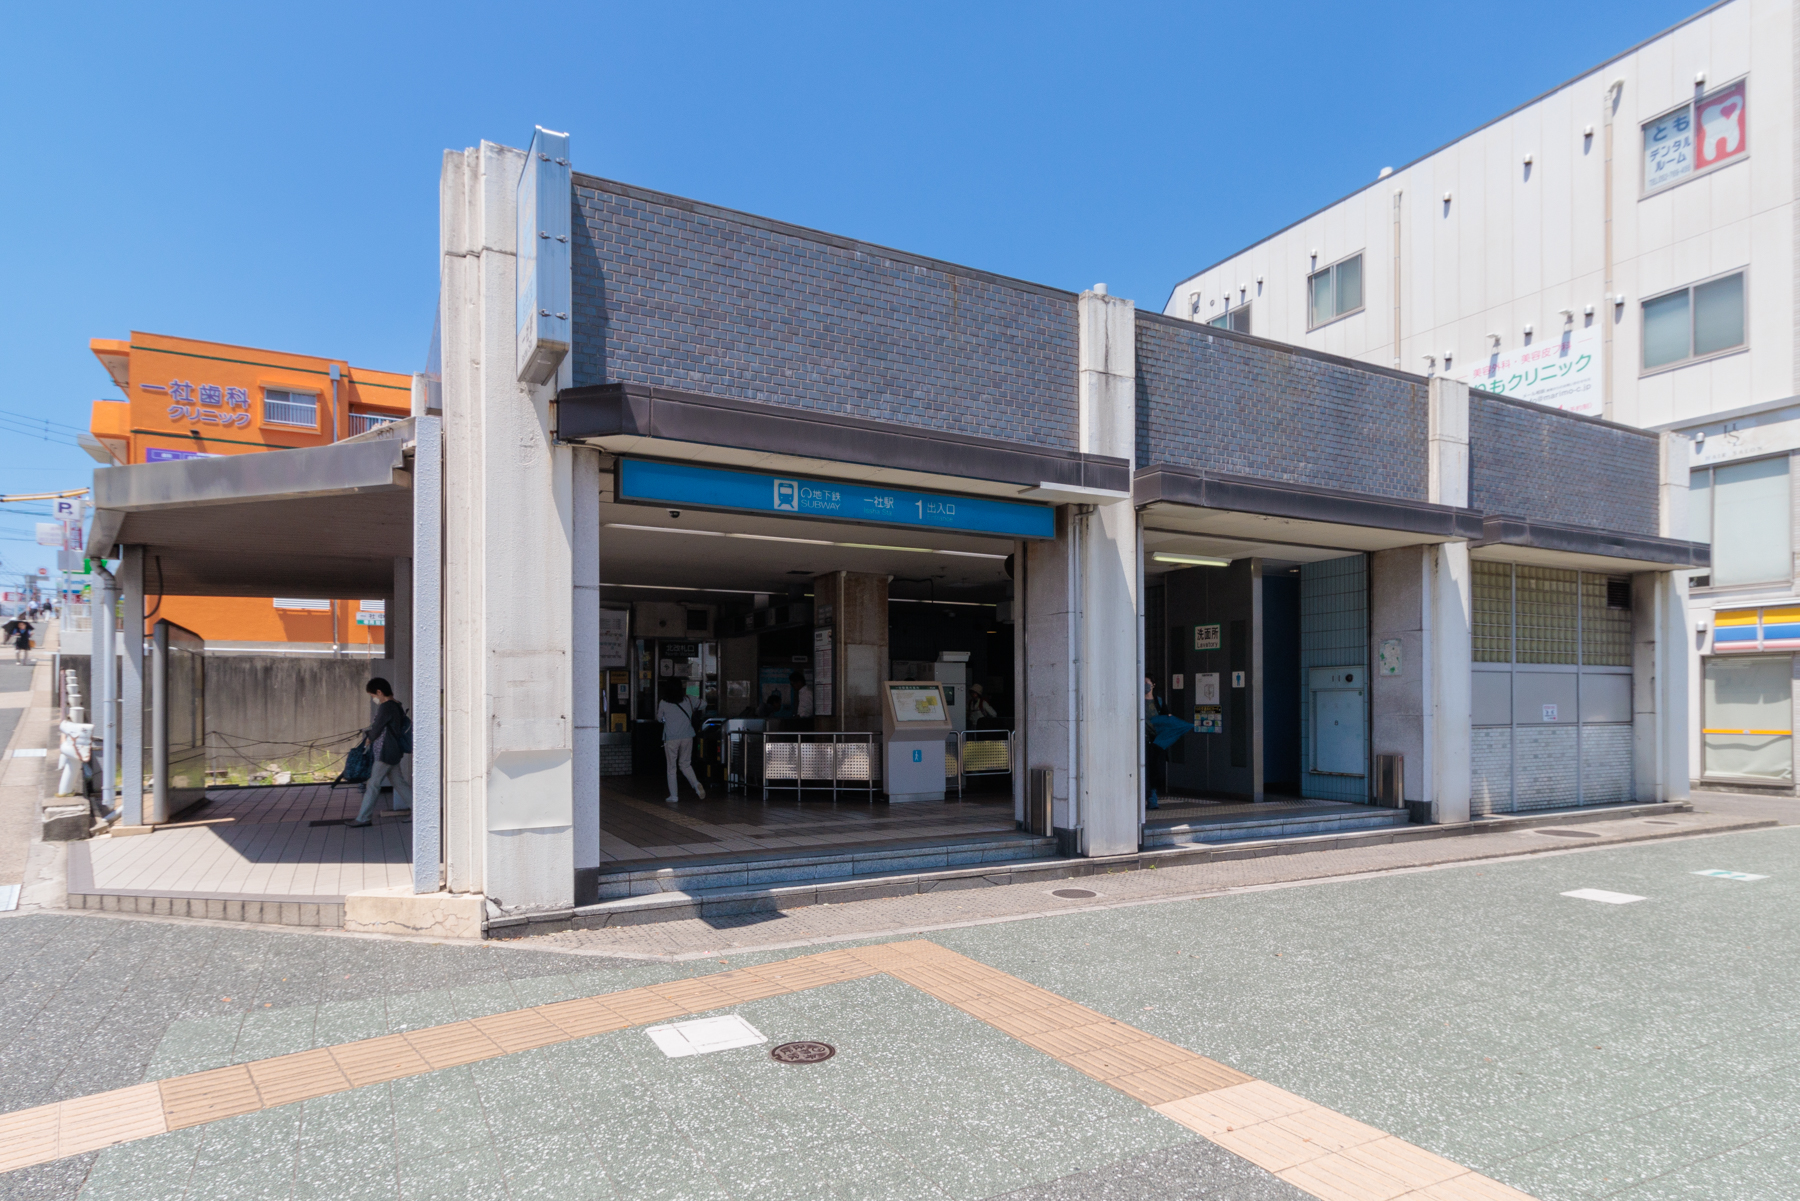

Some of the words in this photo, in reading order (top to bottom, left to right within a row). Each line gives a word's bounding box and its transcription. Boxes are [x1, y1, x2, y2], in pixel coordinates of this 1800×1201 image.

[1653, 115, 1691, 142] とも
[1650, 135, 1692, 162] デンタル
[1655, 151, 1687, 173] ルーム
[139, 378, 251, 409] 一社歯科
[167, 404, 251, 426] クリニック
[813, 489, 841, 502] 地下鉄
[58, 502, 72, 513] P
[800, 499, 841, 511] SUBWAY
[864, 496, 894, 509] 一社駅
[915, 499, 922, 519] 1
[927, 502, 955, 515] 出入口
[1197, 627, 1219, 640] 洗面所
[1197, 641, 1219, 649] Lavatory
